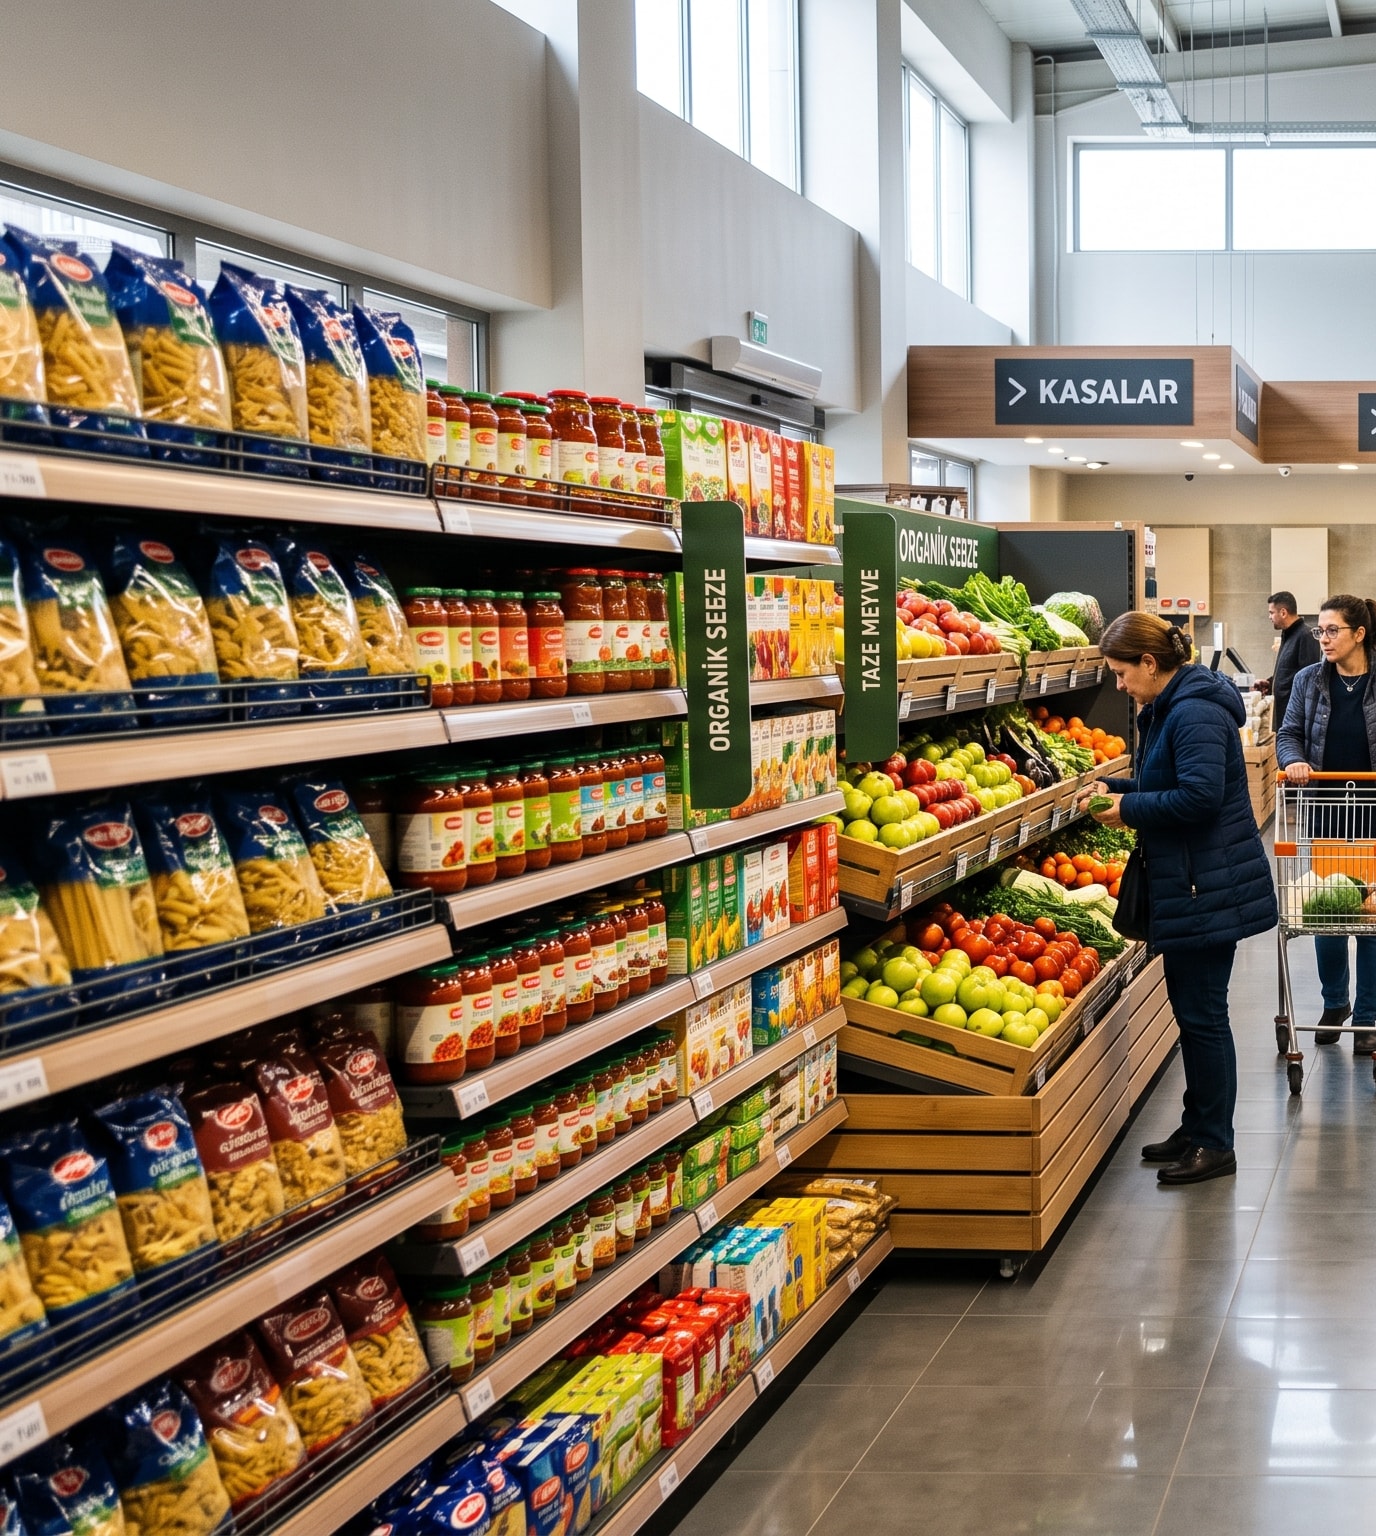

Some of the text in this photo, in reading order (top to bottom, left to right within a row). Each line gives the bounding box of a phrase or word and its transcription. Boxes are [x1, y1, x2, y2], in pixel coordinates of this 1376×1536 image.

[1039, 379, 1178, 404] KASALAR
[899, 525, 979, 569] ORGANİK SEBZE
[860, 568, 881, 692] TAZE MEYVE
[701, 646, 731, 752] ORGANİK
